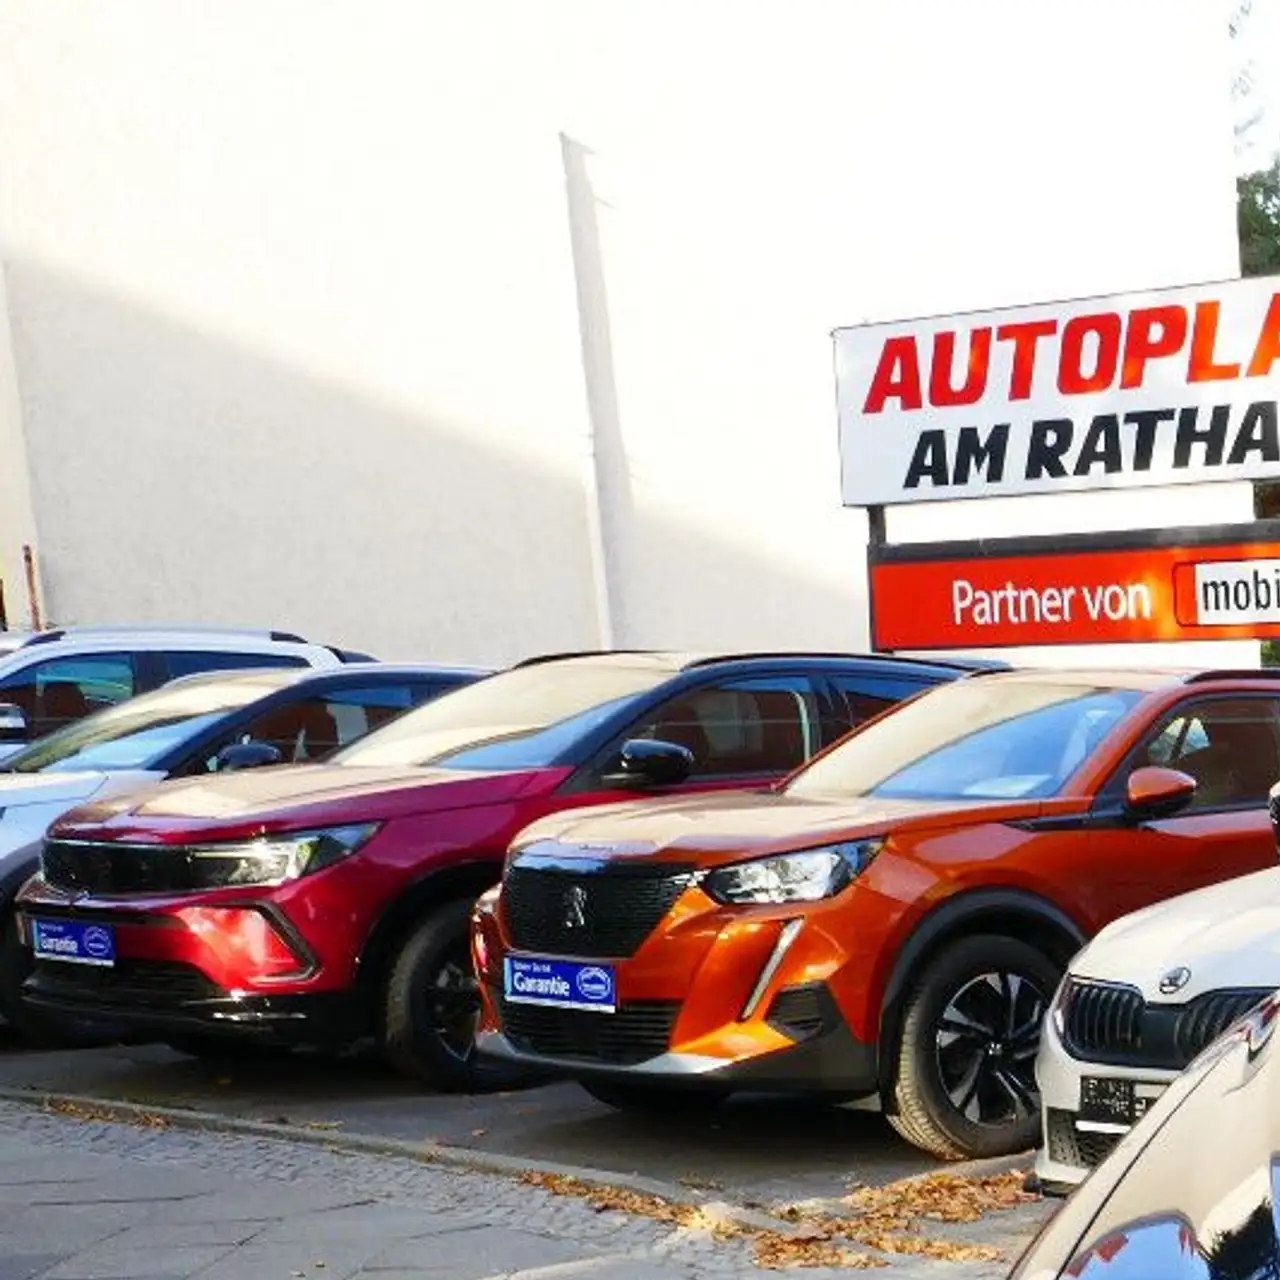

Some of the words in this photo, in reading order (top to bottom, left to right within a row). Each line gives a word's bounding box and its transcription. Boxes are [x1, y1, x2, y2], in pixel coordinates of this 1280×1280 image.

[904, 422, 1010, 488] AM
[952, 579, 1075, 625] Partner
[1082, 580, 1151, 620] von
[513, 971, 570, 996] Garantie
